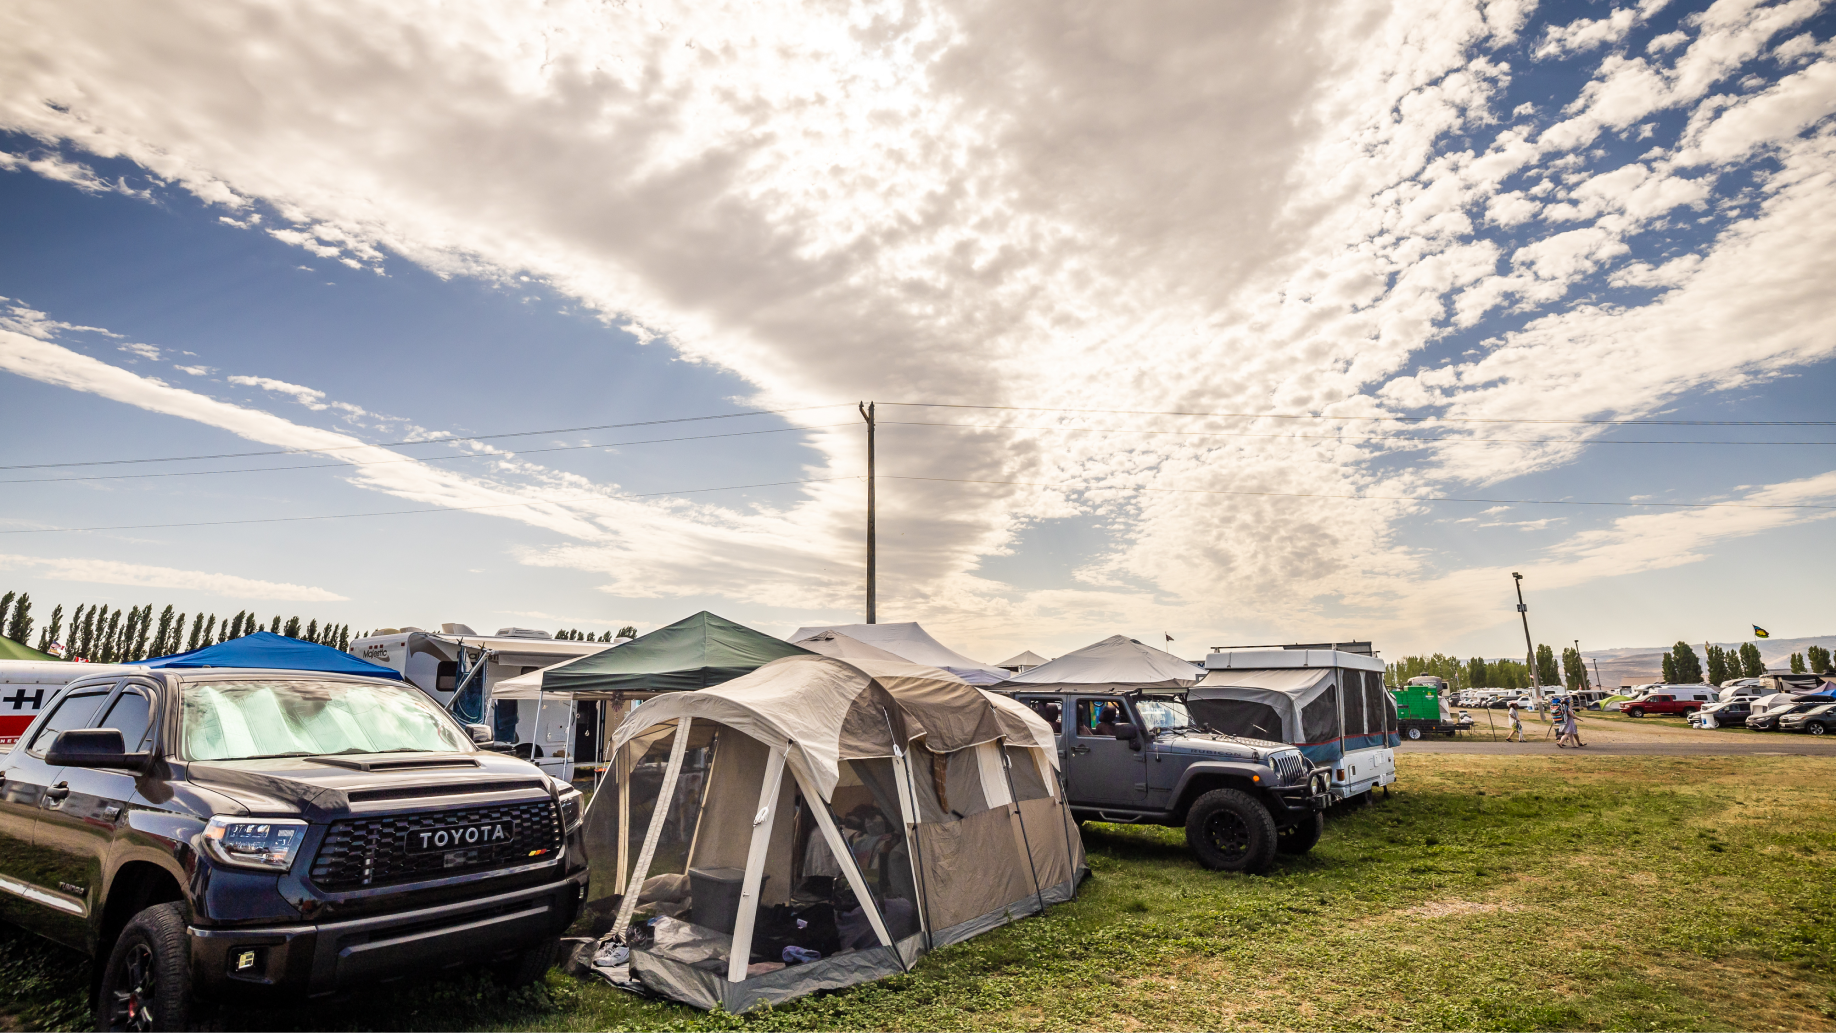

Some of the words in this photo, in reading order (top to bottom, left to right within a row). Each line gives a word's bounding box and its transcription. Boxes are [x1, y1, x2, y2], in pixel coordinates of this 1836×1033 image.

[363, 649, 387, 659] Majestic
[1190, 748, 1242, 757] RUBICON
[419, 824, 505, 849] TOYOTA
